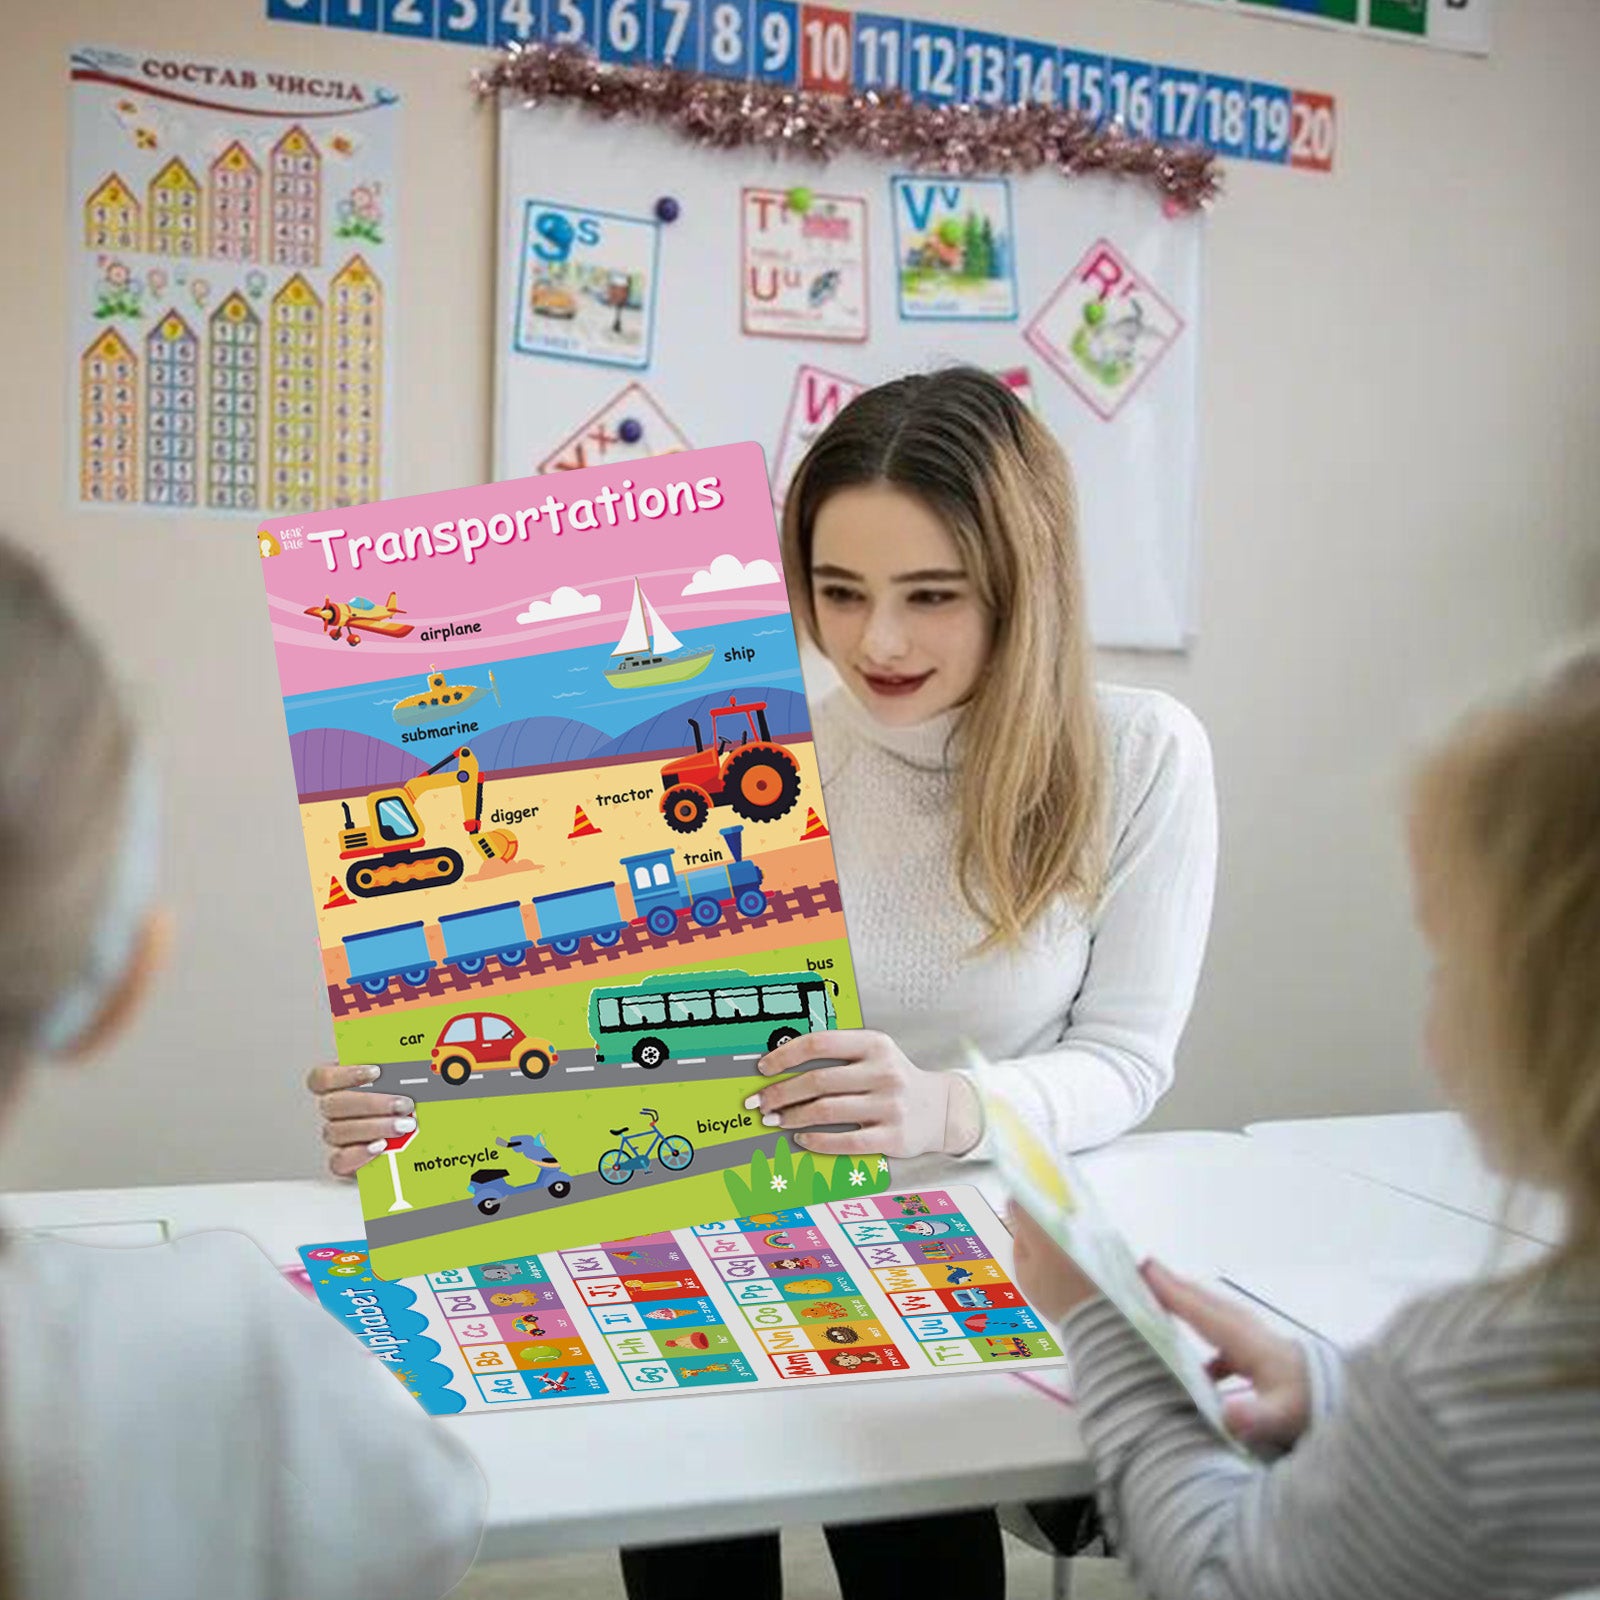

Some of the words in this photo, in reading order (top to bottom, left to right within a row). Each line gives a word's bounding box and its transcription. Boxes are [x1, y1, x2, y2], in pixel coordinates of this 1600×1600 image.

[142, 59, 257, 88] СОСТАВ
[266, 72, 364, 102] ЧИСЛА
[501, 0, 534, 39] 4
[555, 0, 584, 43] 5
[608, 0, 639, 51] 6
[662, 1, 690, 57] 7
[712, 4, 742, 64] 8
[762, 12, 791, 71] 9
[805, 19, 848, 81] 10
[859, 28, 899, 89] 11
[912, 34, 956, 96] 12
[966, 43, 1005, 104] 13
[1013, 53, 1055, 106] 14
[1064, 62, 1104, 122] 15
[1111, 71, 1152, 136] 16
[1159, 79, 1198, 136] 17
[1204, 87, 1246, 145] 18
[1250, 96, 1288, 152] 19
[1292, 103, 1333, 159] 20
[307, 474, 724, 573] Transportations
[420, 623, 482, 642] airplane
[724, 647, 755, 662] ship
[401, 720, 479, 742] submarine
[596, 788, 654, 807] tractor
[491, 806, 539, 825] digger
[683, 850, 723, 865] train
[806, 958, 834, 971] bus
[399, 1033, 425, 1046] car
[696, 1113, 752, 1134] bicycle
[413, 1147, 499, 1174] motorcycle
[840, 1202, 870, 1219] Zz
[713, 1239, 740, 1254] Rr
[572, 1257, 604, 1272] Kk
[870, 1247, 901, 1265] Xx
[726, 1259, 757, 1278] Qq
[587, 1284, 622, 1298] Jj
[740, 1284, 773, 1300] Pp
[444, 1295, 477, 1312] Dd
[602, 1313, 632, 1325] Ii
[755, 1307, 783, 1324] Oo
[340, 1288, 409, 1362] Alphabet
[462, 1323, 489, 1338] Cc
[918, 1319, 949, 1336] Uu
[616, 1337, 649, 1356] Hh
[768, 1330, 800, 1350] Nn
[473, 1351, 504, 1367] Bb
[934, 1345, 964, 1362] Tt
[635, 1367, 668, 1384] Gg
[490, 1378, 518, 1395] Aa
